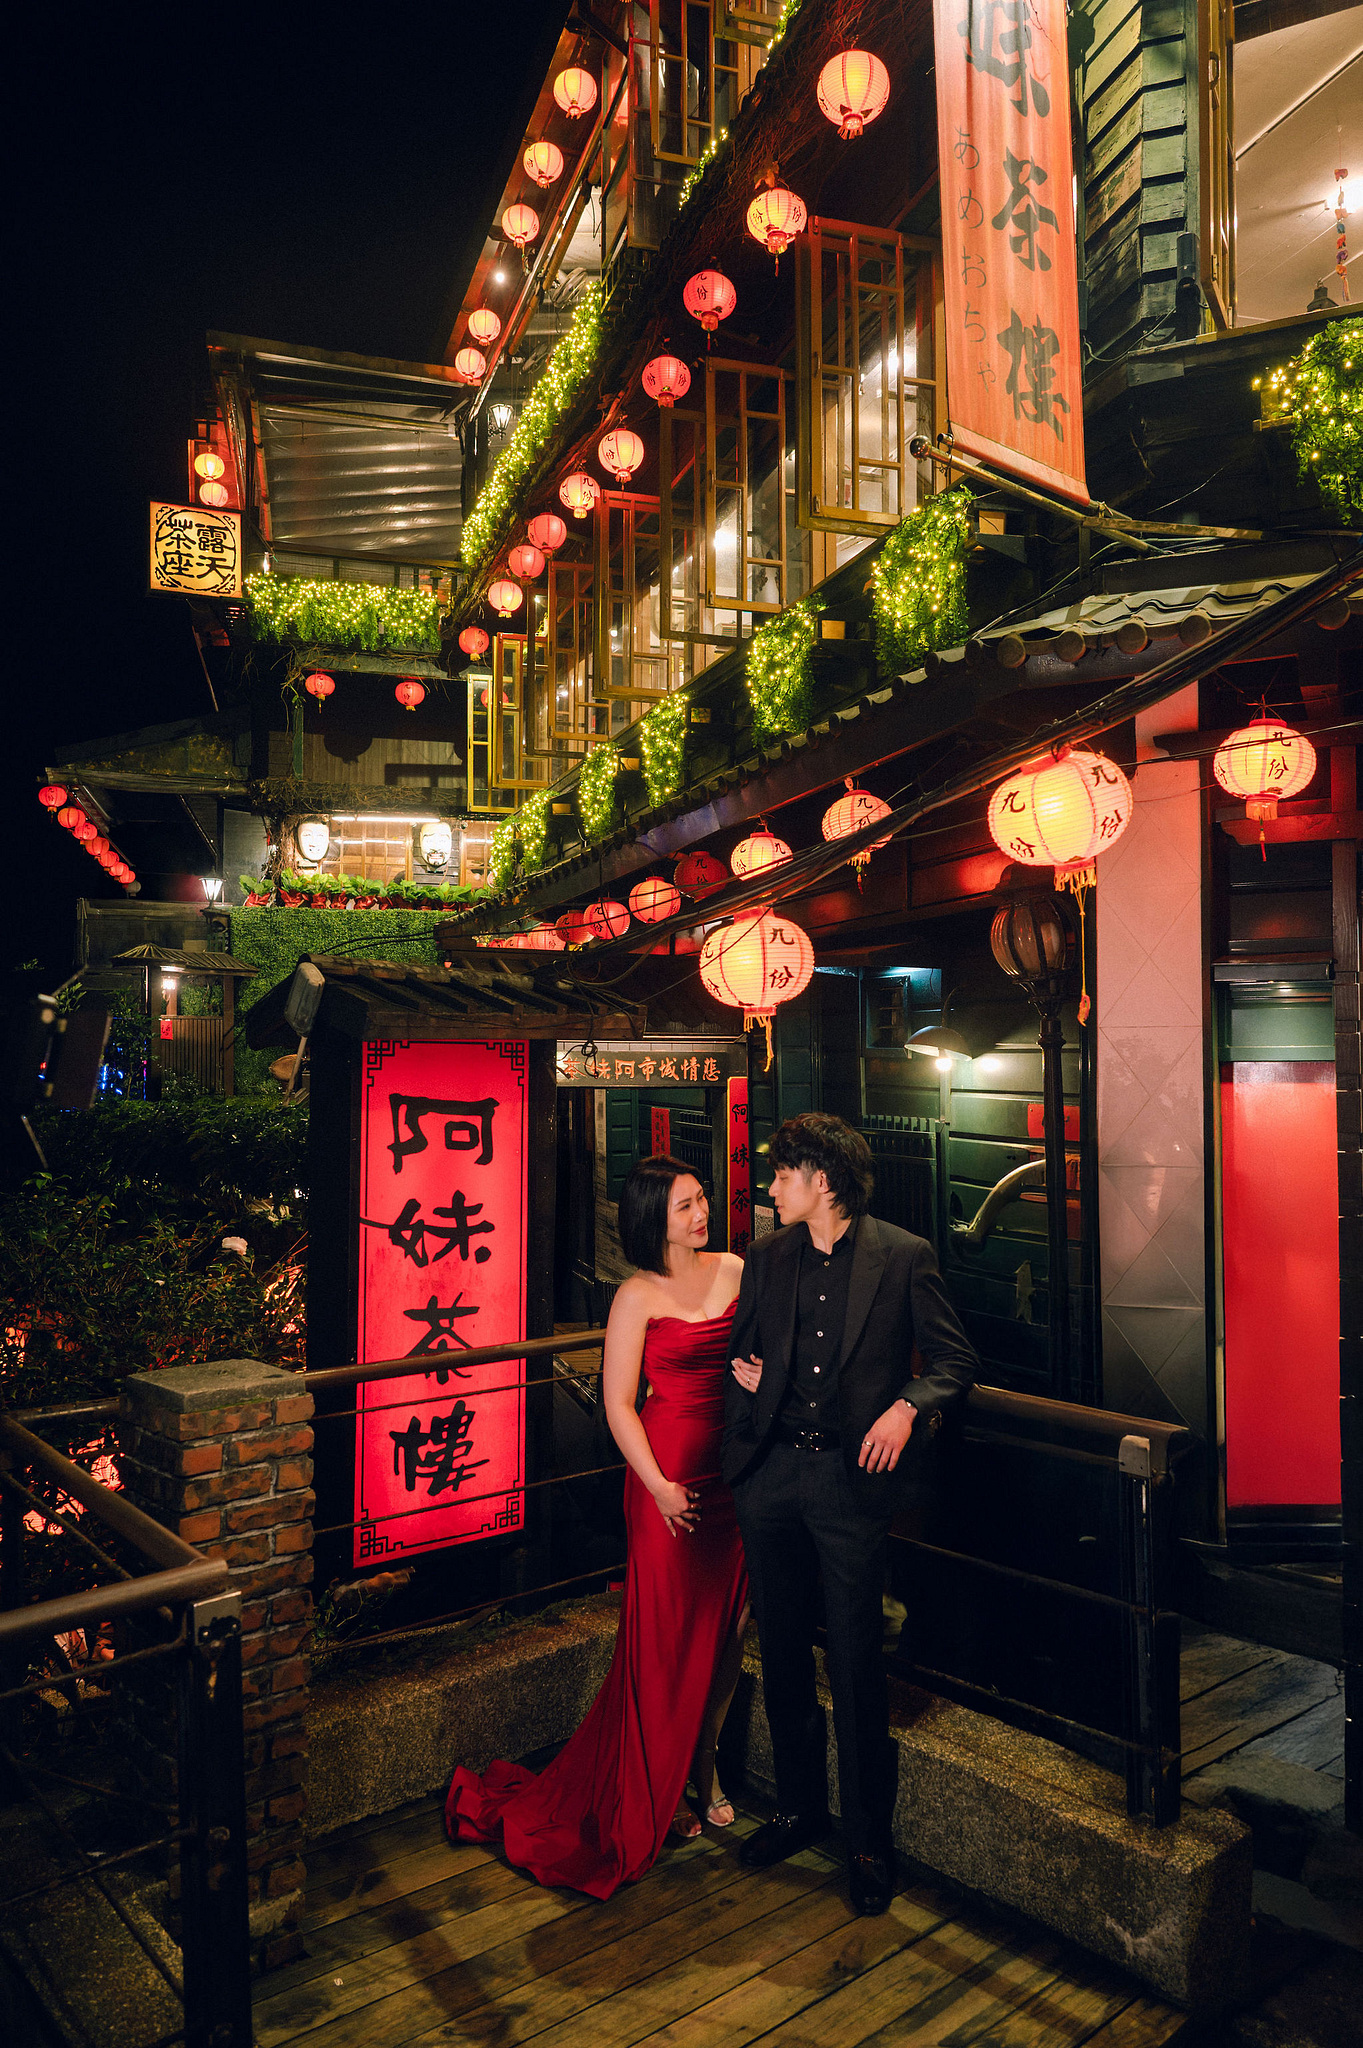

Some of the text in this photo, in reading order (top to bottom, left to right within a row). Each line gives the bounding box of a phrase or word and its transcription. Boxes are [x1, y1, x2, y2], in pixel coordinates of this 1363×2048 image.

[953, 127, 996, 392] あめおちゃ
[1268, 731, 1292, 780] 九份
[999, 790, 1037, 858] 九份
[1090, 764, 1123, 840] 九份
[769, 927, 795, 989] 九份
[360, 1093, 501, 1497] 阿妹茶樓
